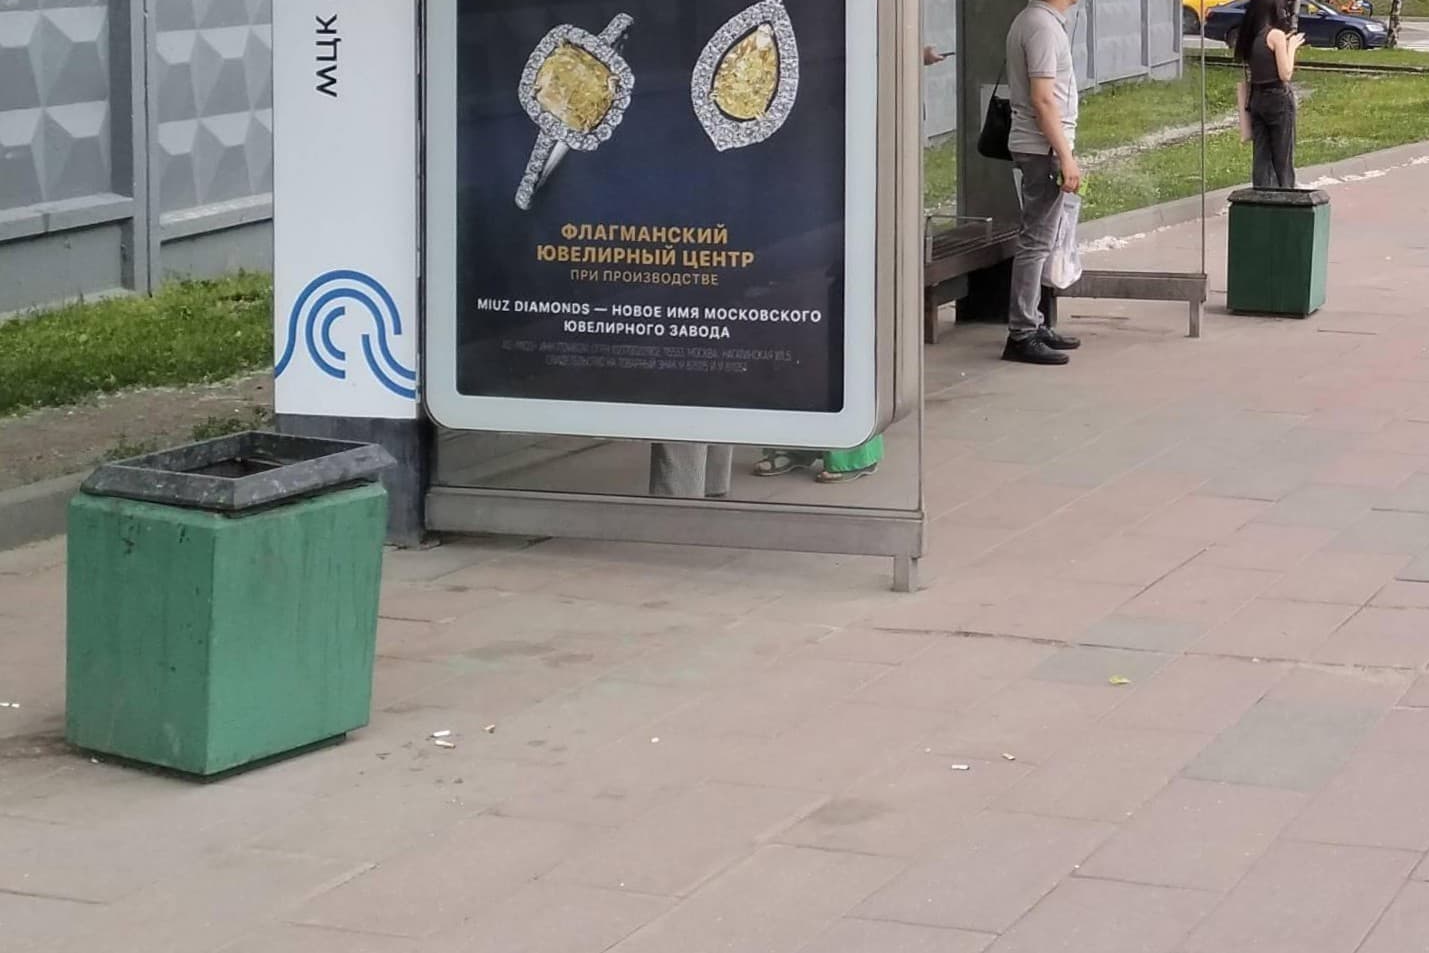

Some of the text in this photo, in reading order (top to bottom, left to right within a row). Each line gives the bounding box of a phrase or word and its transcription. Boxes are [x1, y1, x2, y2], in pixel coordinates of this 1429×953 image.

[316, 15, 341, 97] МЦК
[561, 223, 728, 245] ФЛАГМАНСКИЙ
[537, 244, 754, 268] ЮВЕЛИРНЫЙ ЦЕНТР
[571, 269, 719, 287] ПРИ ПРОИЗВОДСТВЕ
[478, 299, 509, 311] MIUZ
[515, 301, 589, 314] DIAMONDS
[612, 305, 661, 317] НОВОЕ
[667, 307, 699, 318] ИМЯ
[705, 308, 821, 322] МОСКОВСКОГО
[564, 320, 730, 339] ЮВЕЛИРНОГО ЗАВОДА
